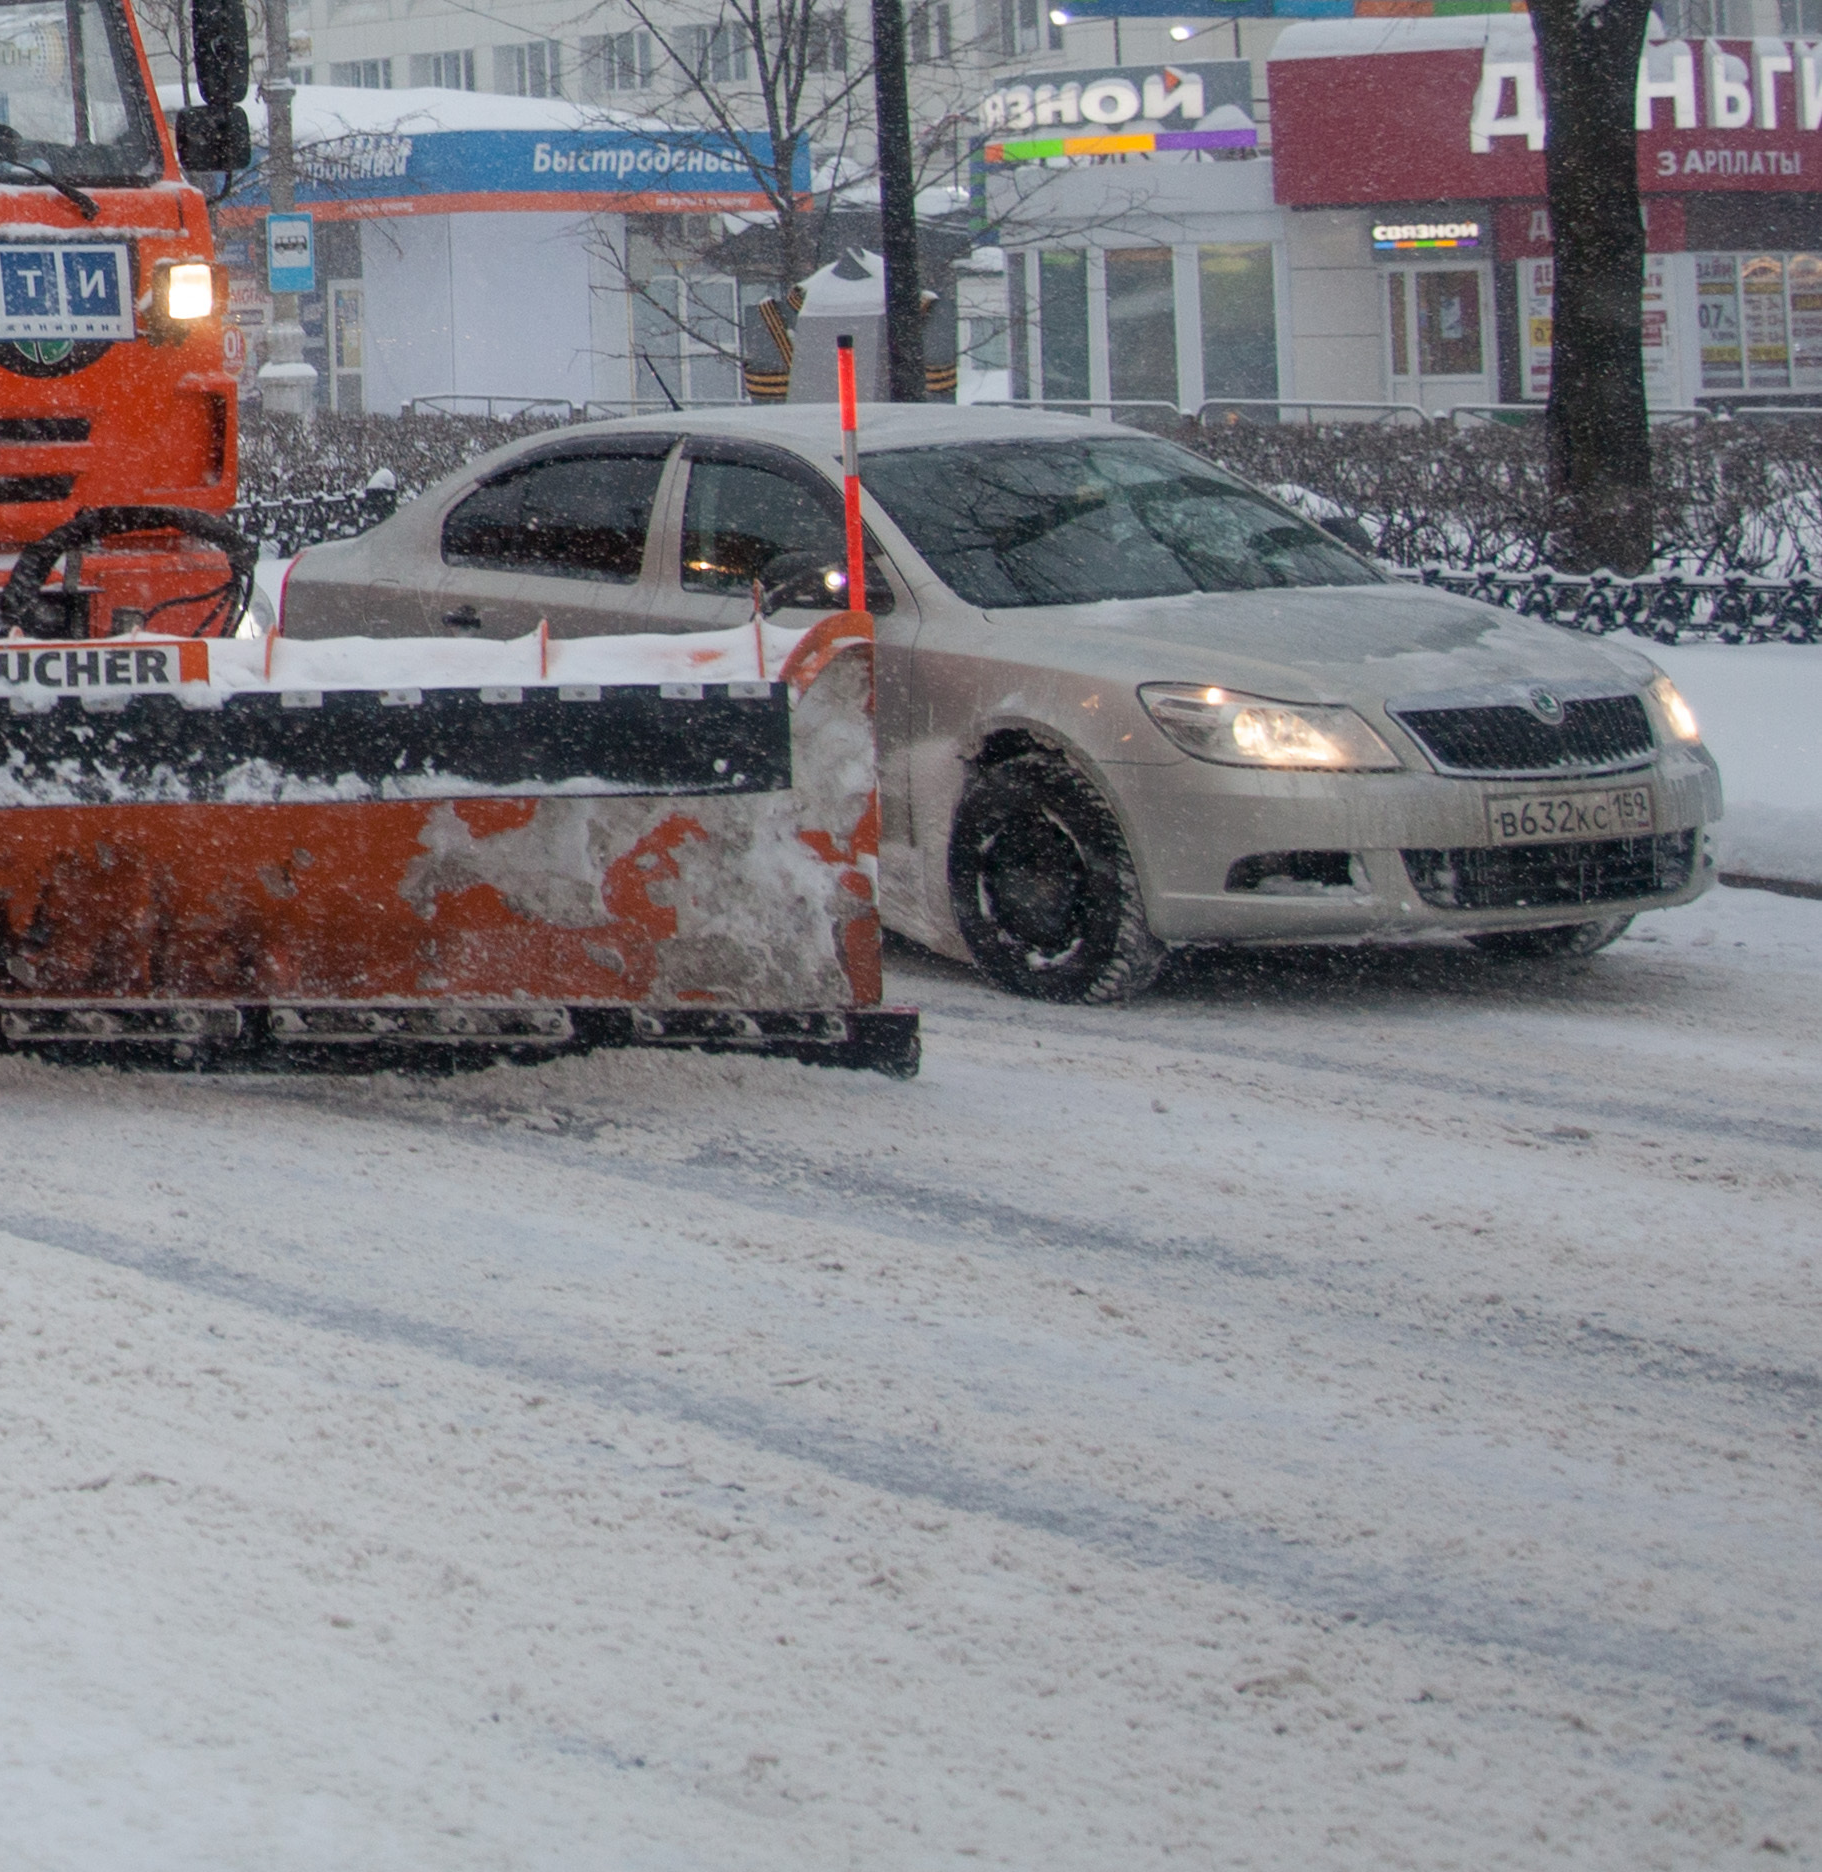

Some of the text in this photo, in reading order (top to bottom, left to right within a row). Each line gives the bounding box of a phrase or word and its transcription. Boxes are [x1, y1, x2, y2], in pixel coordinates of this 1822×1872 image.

[1470, 50, 1822, 154] ДНЬГ
[532, 142, 751, 179] Быстроденьги
[1372, 221, 1479, 241] СВЯЗНОЙ
[1500, 791, 1648, 838] В632КС 159
